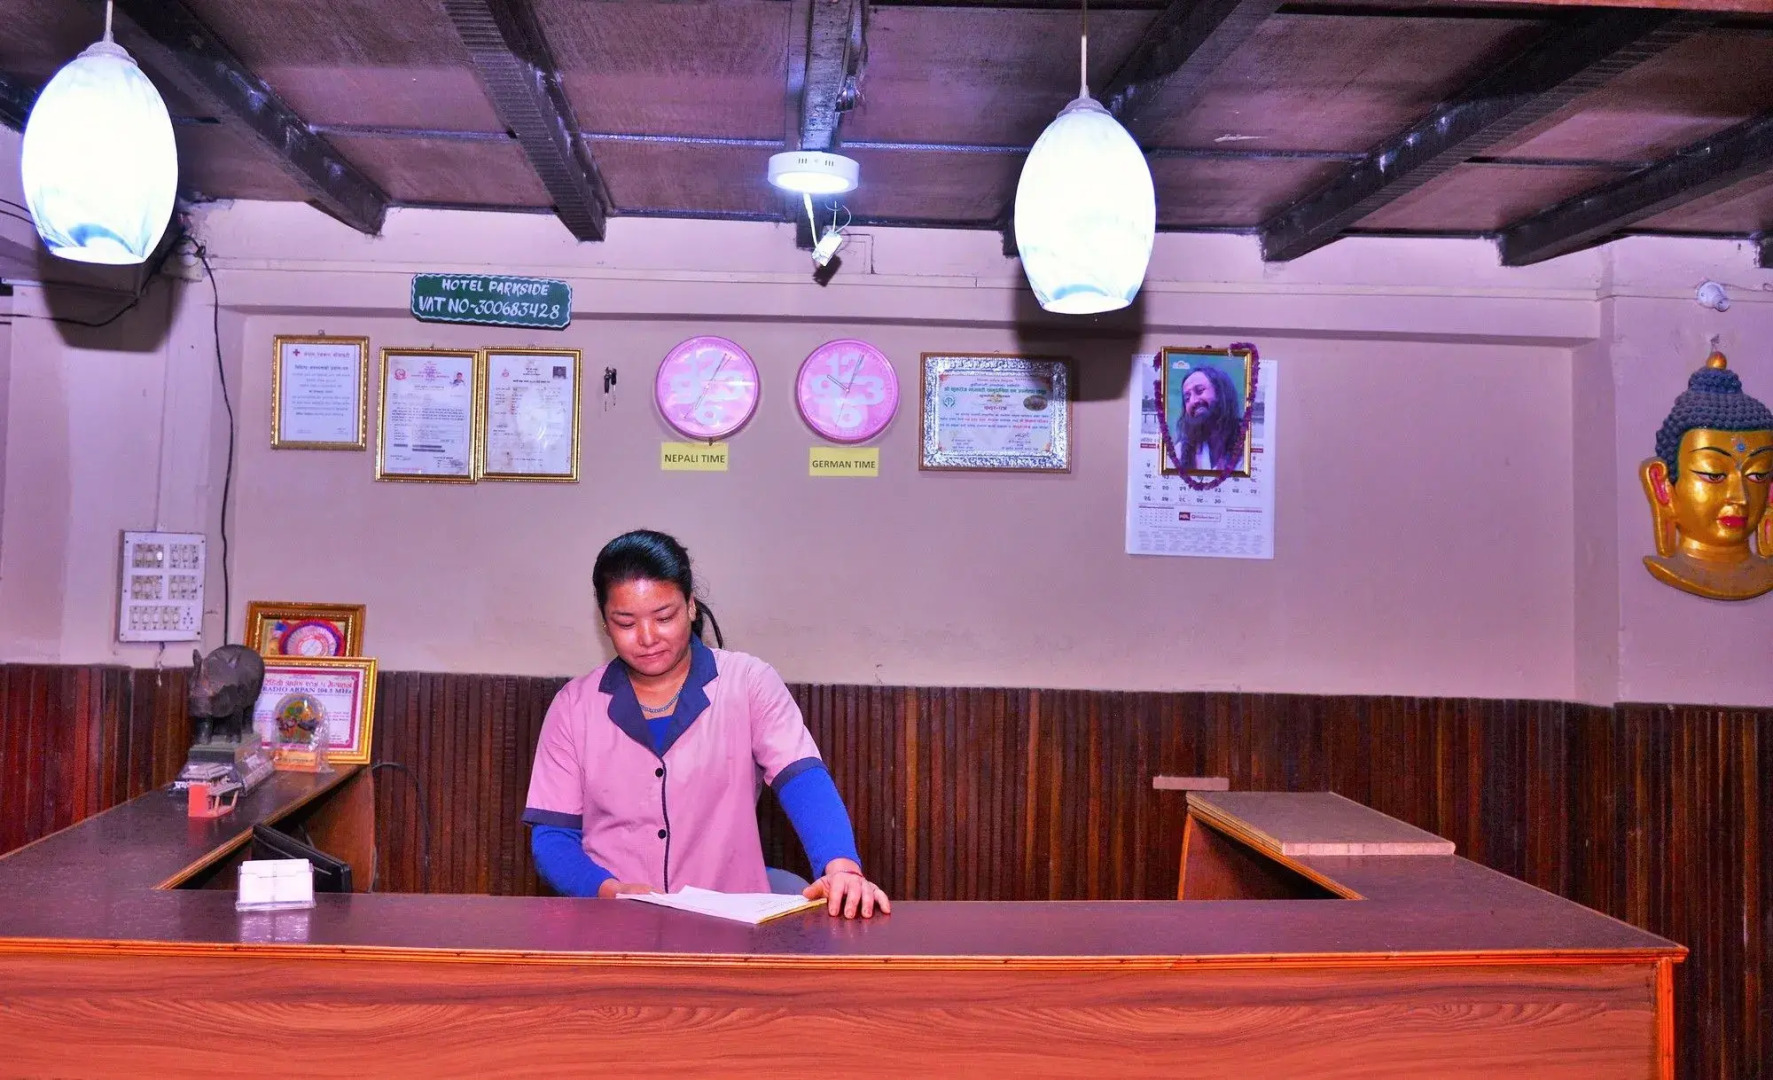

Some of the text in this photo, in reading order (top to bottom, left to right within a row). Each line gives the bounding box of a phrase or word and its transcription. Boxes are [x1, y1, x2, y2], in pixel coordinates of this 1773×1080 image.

[442, 278, 550, 296] HOTEL PARKSIDE
[418, 296, 446, 312] VAT
[664, 454, 725, 464] NEPALI TIME
[812, 460, 876, 469] GERMAN TIME
